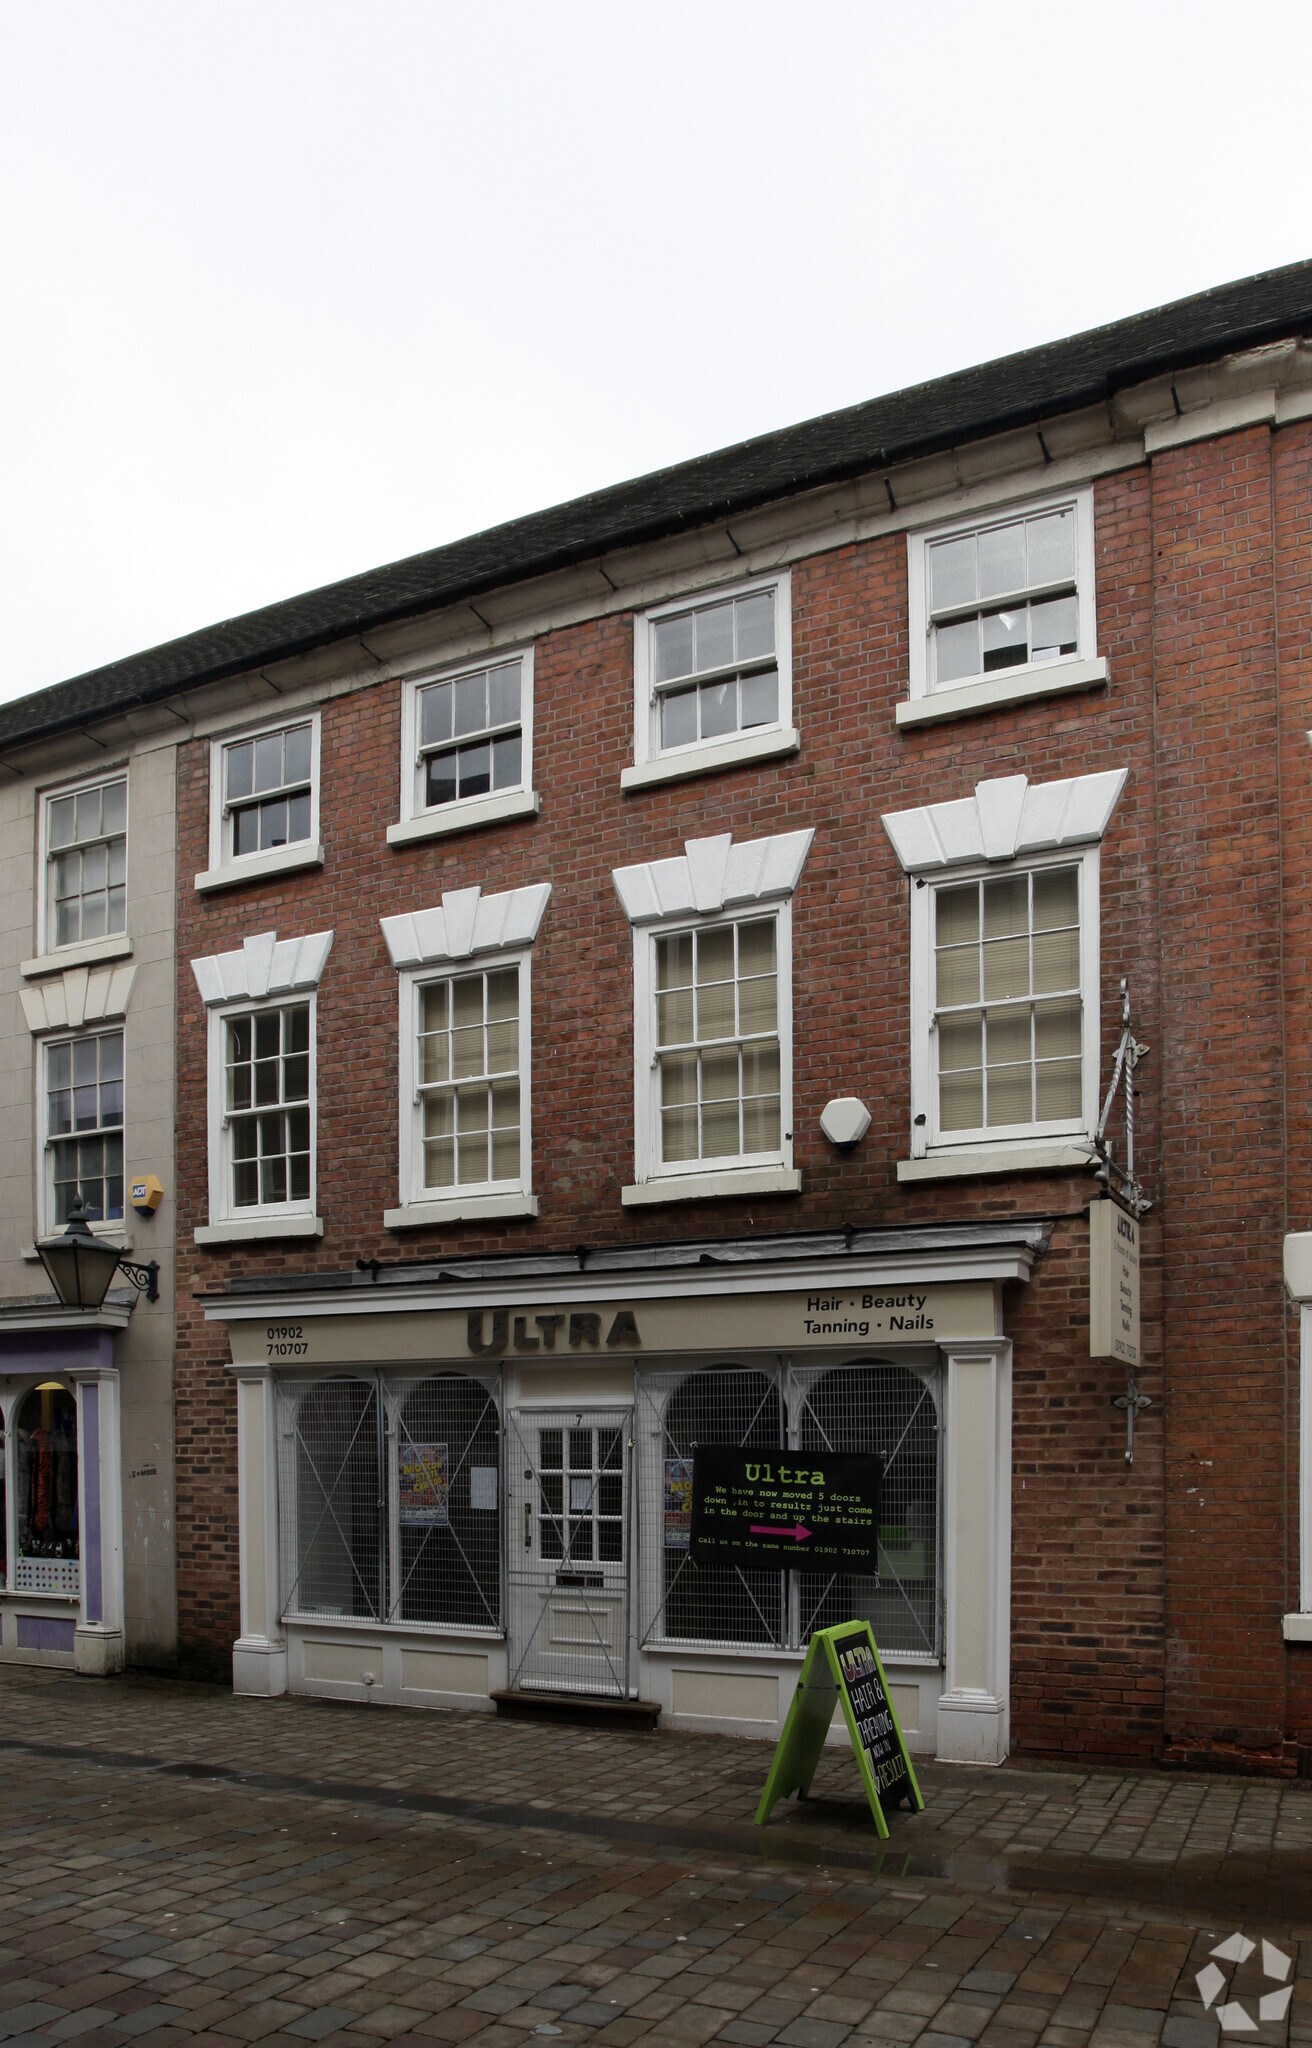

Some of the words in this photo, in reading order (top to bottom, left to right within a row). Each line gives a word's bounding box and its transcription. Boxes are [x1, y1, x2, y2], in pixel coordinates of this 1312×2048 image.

[133, 1187, 146, 1196] ADT
[1118, 1214, 1134, 1245] ULTRA
[1120, 1281, 1132, 1301] Beauty
[807, 1296, 843, 1311] Hair
[861, 1294, 927, 1311] Beauty
[267, 1326, 303, 1340] 01902
[467, 1310, 641, 1356] ULTRA
[804, 1319, 869, 1336] Tanning
[889, 1314, 934, 1330] Nails
[266, 1343, 308, 1356] 710707
[576, 1414, 583, 1426] 7
[745, 1463, 826, 1485] Ultra
[715, 1486, 727, 1494] We
[731, 1487, 754, 1496] have
[782, 1491, 813, 1500] moved
[818, 1492, 824, 1500] 5
[829, 1493, 861, 1502] doors
[704, 1496, 727, 1504] down
[770, 1501, 811, 1511] resultz
[817, 1503, 842, 1513] just
[848, 1506, 873, 1514] come
[704, 1506, 715, 1514] in
[720, 1508, 737, 1516] the
[742, 1510, 764, 1518] door
[770, 1512, 788, 1520] and
[793, 1515, 805, 1523] up
[811, 1515, 829, 1523] the
[835, 1517, 872, 1526] stairs
[783, 1544, 810, 1552] number
[814, 1546, 837, 1554] 01902
[842, 1548, 870, 1556] 710707
[839, 1646, 877, 1682] ULTRA
[850, 1682, 877, 1715] HAIR
[873, 1677, 886, 1700] &
